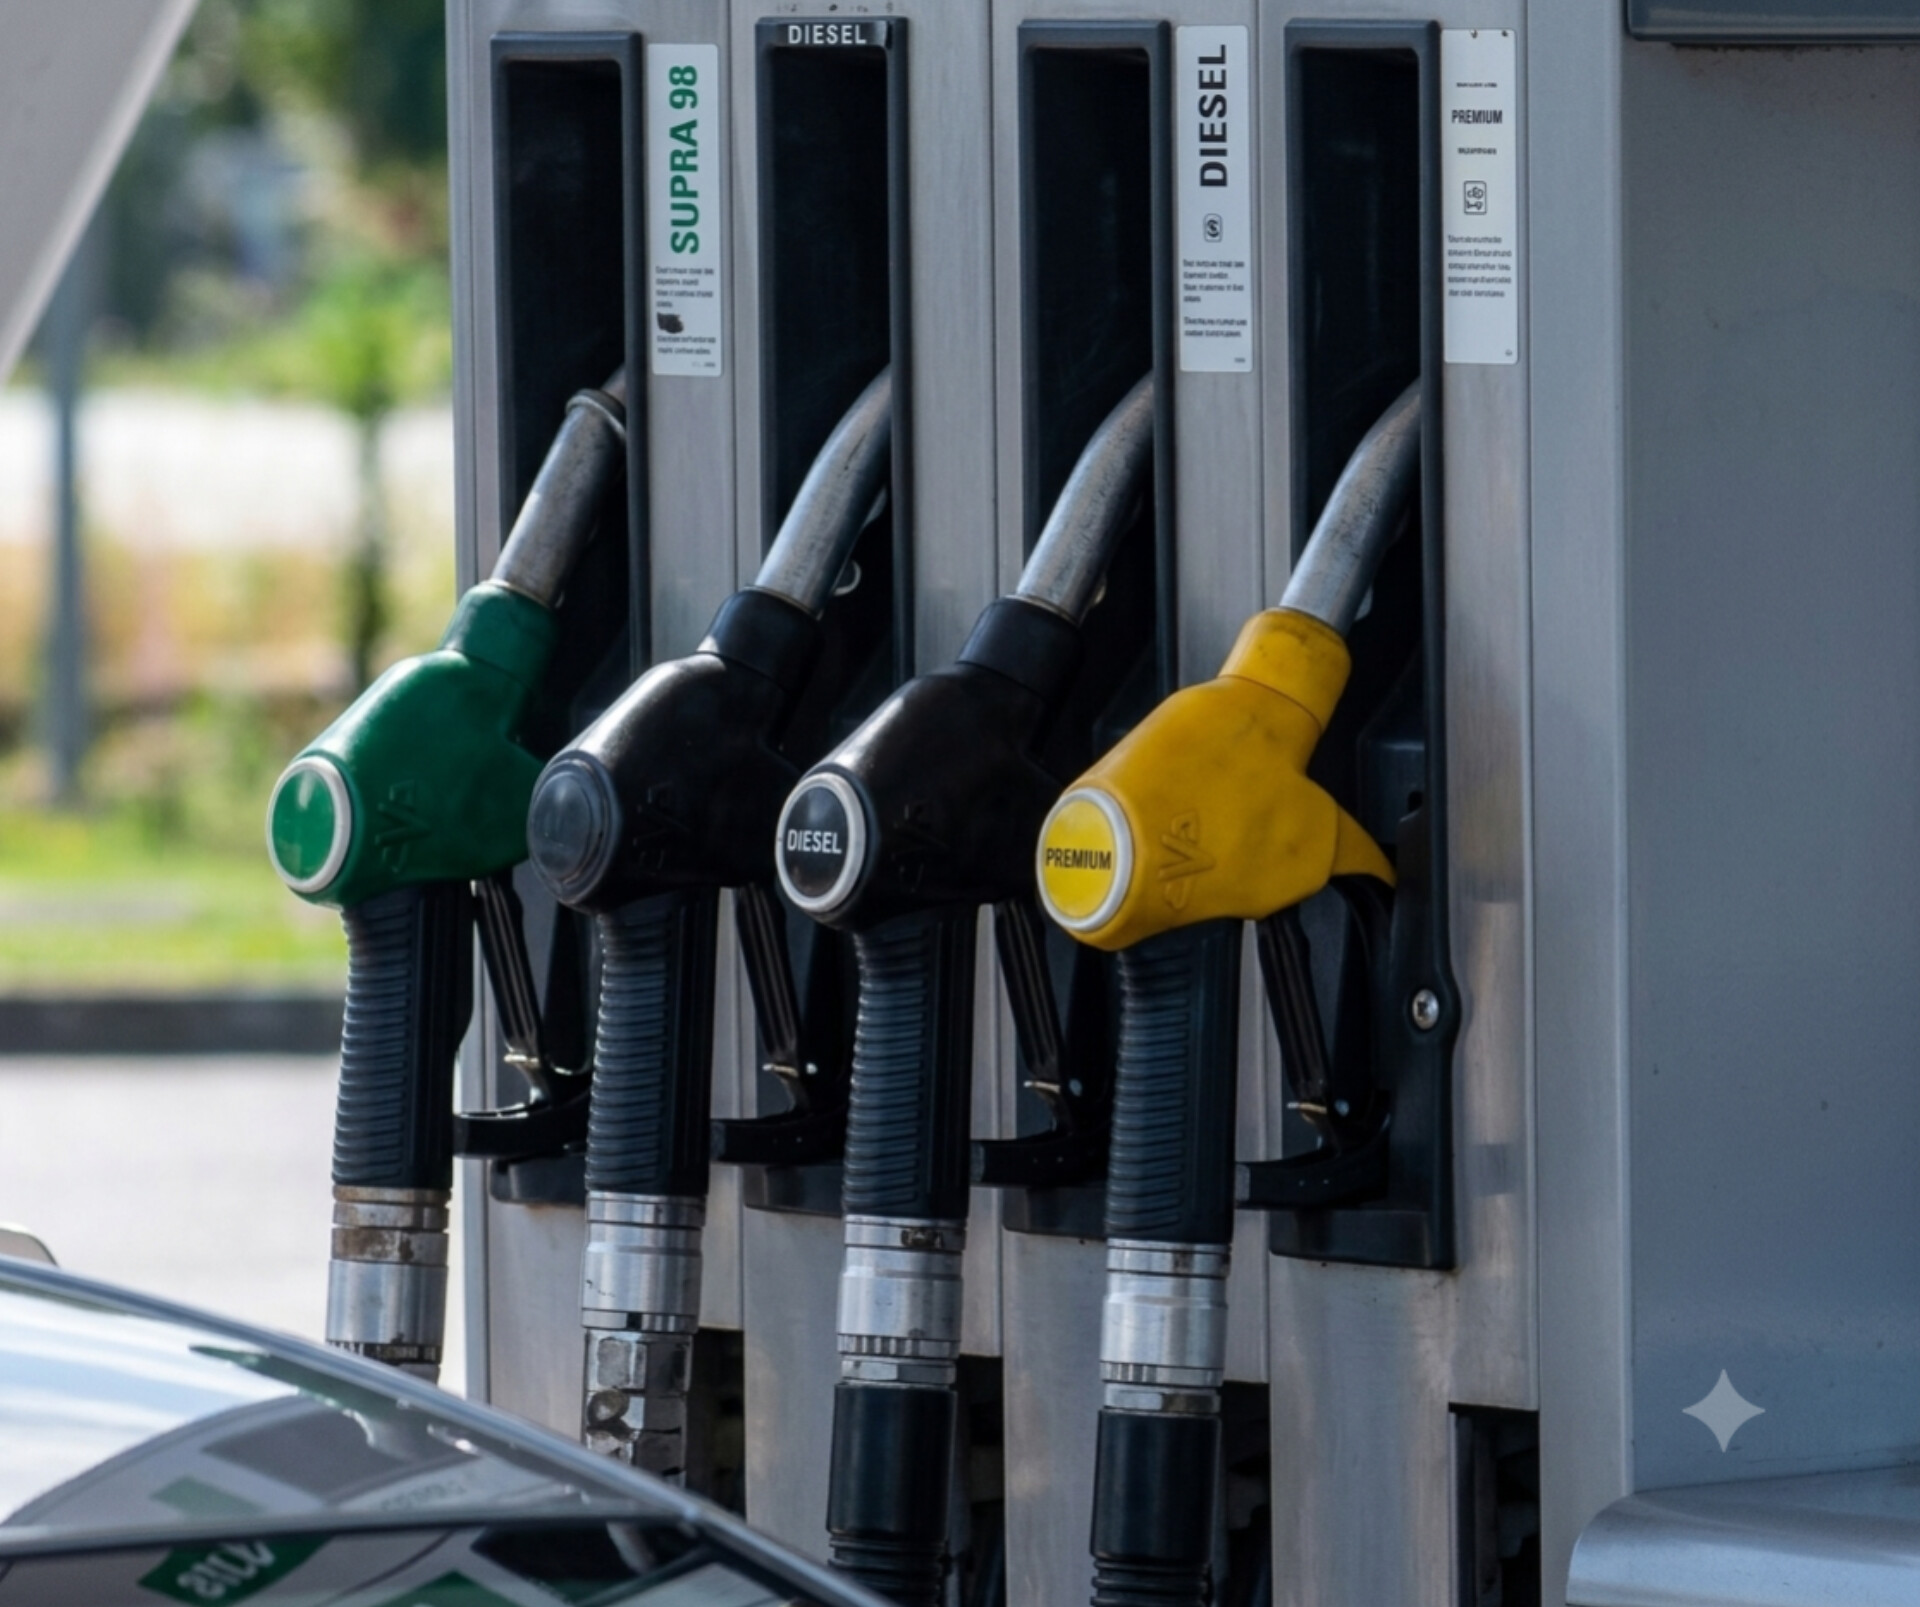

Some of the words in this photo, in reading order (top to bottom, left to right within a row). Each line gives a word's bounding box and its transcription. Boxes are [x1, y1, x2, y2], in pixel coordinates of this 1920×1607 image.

[788, 24, 867, 45] DIESEL
[668, 64, 699, 110] 98
[1198, 44, 1228, 187] DIESEL
[1452, 109, 1503, 124] PREMIUM
[669, 118, 700, 255] SUPRA
[787, 828, 843, 855] DIESEL
[1046, 847, 1112, 870] PREMIUM
